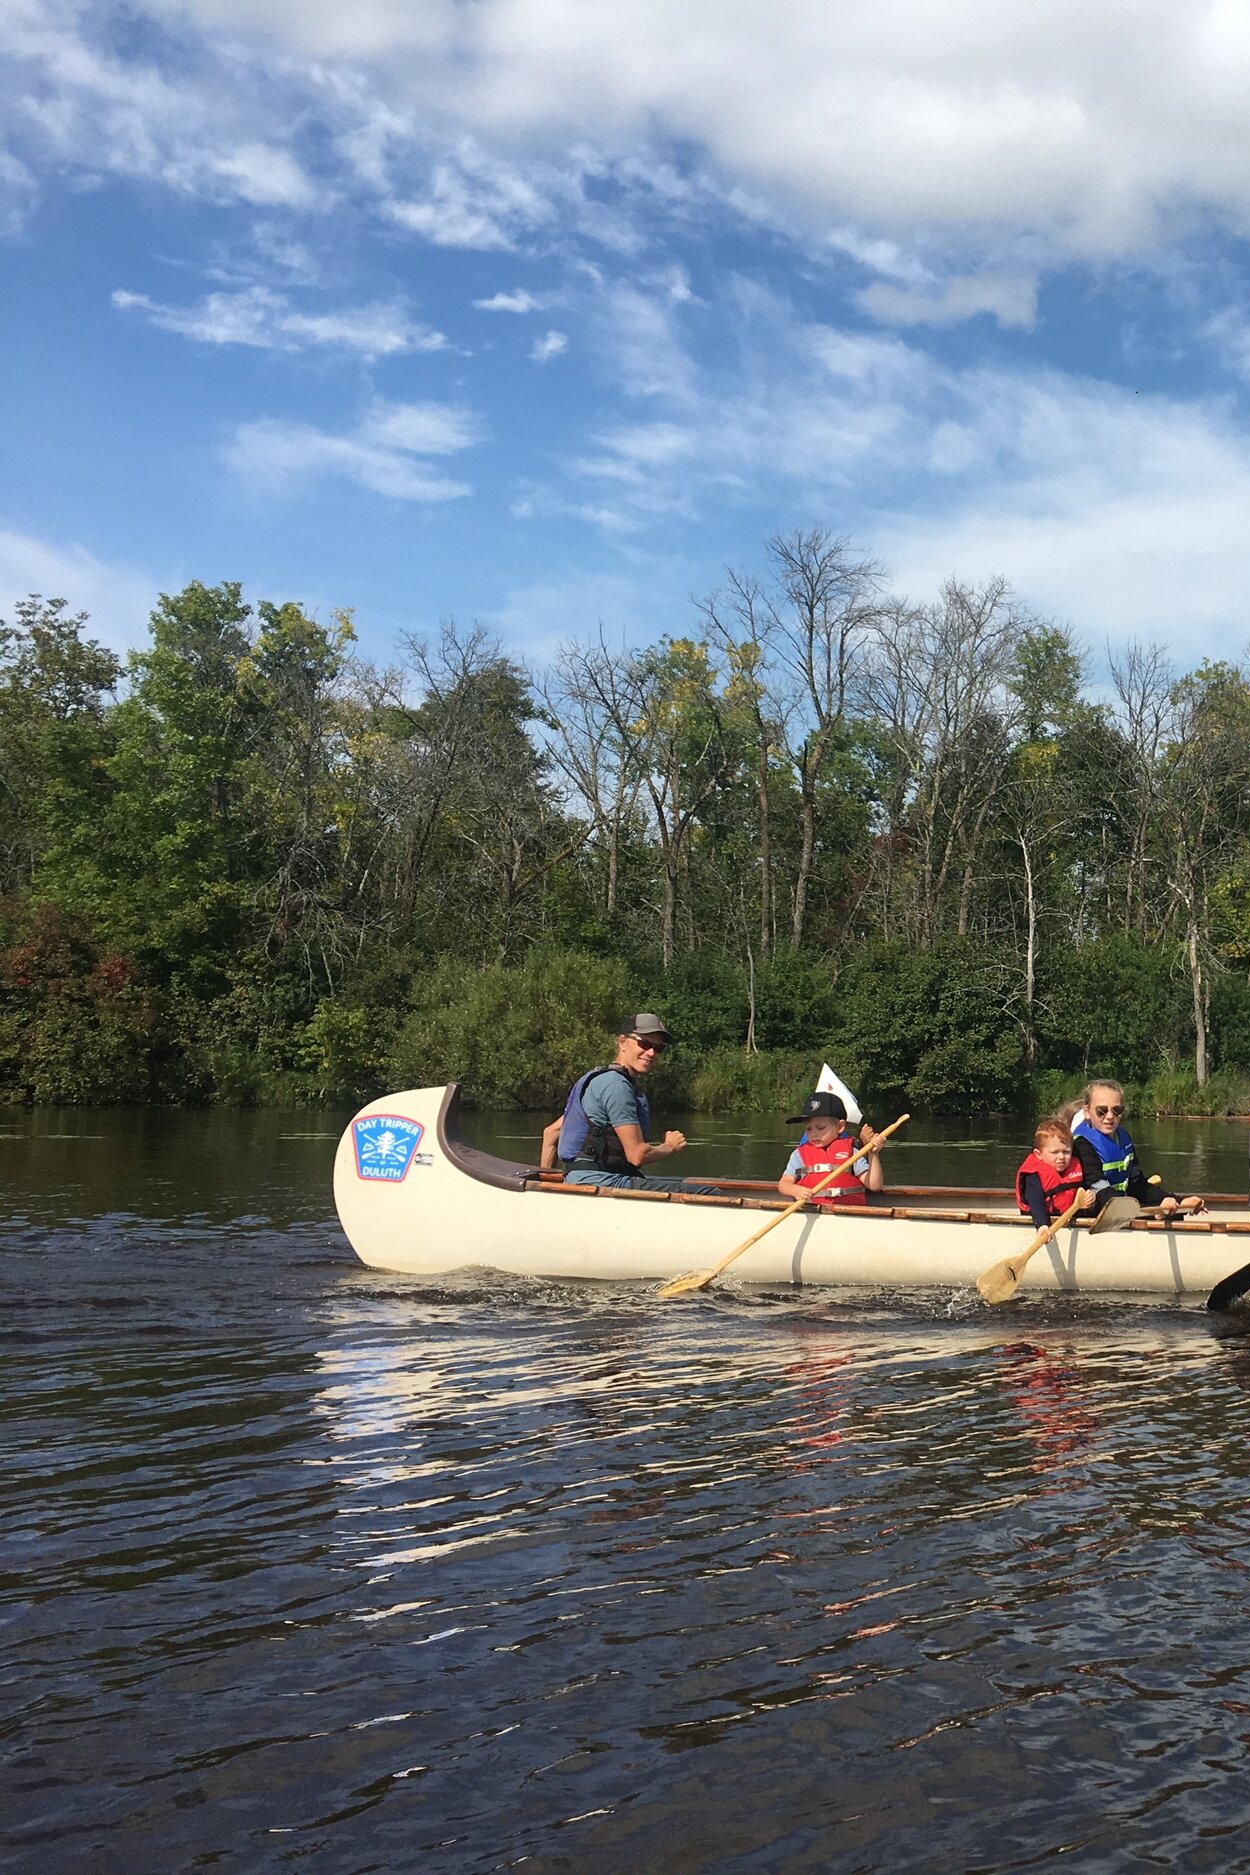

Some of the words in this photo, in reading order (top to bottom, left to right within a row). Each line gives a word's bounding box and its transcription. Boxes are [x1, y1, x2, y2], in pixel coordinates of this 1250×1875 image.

[357, 1119, 377, 1132] DAY
[379, 1118, 419, 1136] TRIPPER
[362, 1166, 401, 1178] DULUTH
